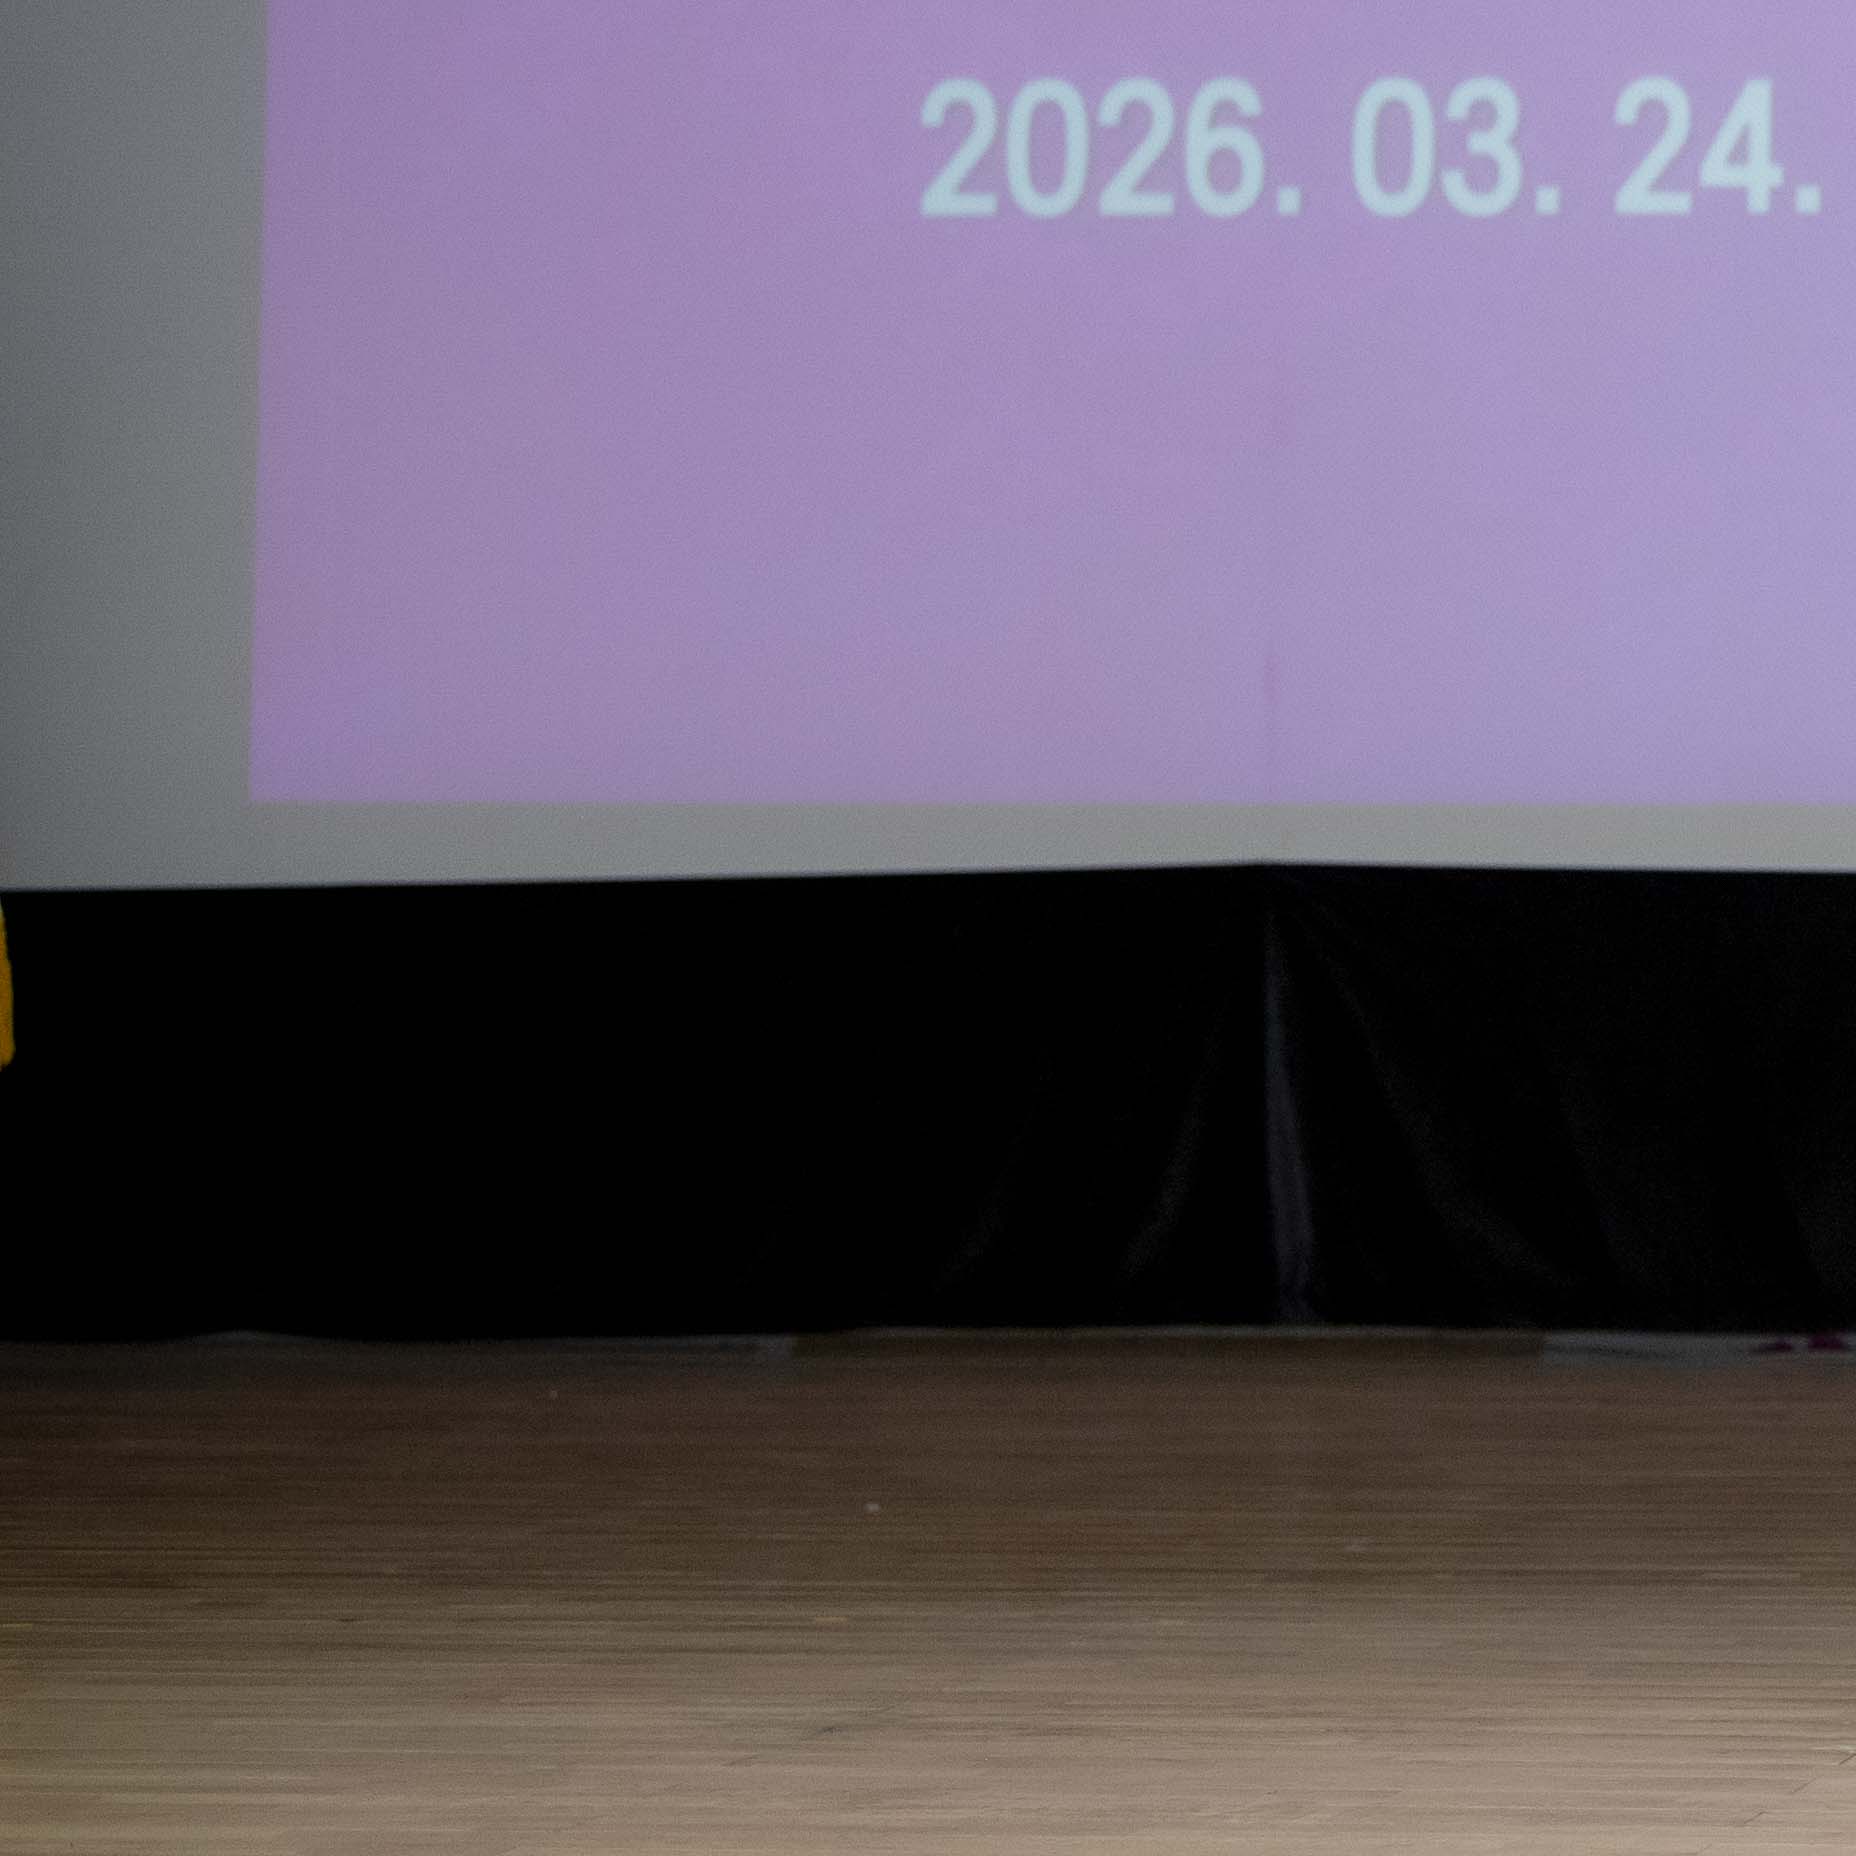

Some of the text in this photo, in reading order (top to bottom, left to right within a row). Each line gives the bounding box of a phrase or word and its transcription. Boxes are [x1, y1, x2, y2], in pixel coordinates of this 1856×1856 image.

[919, 74, 1822, 219] 2026. 03. 24.
